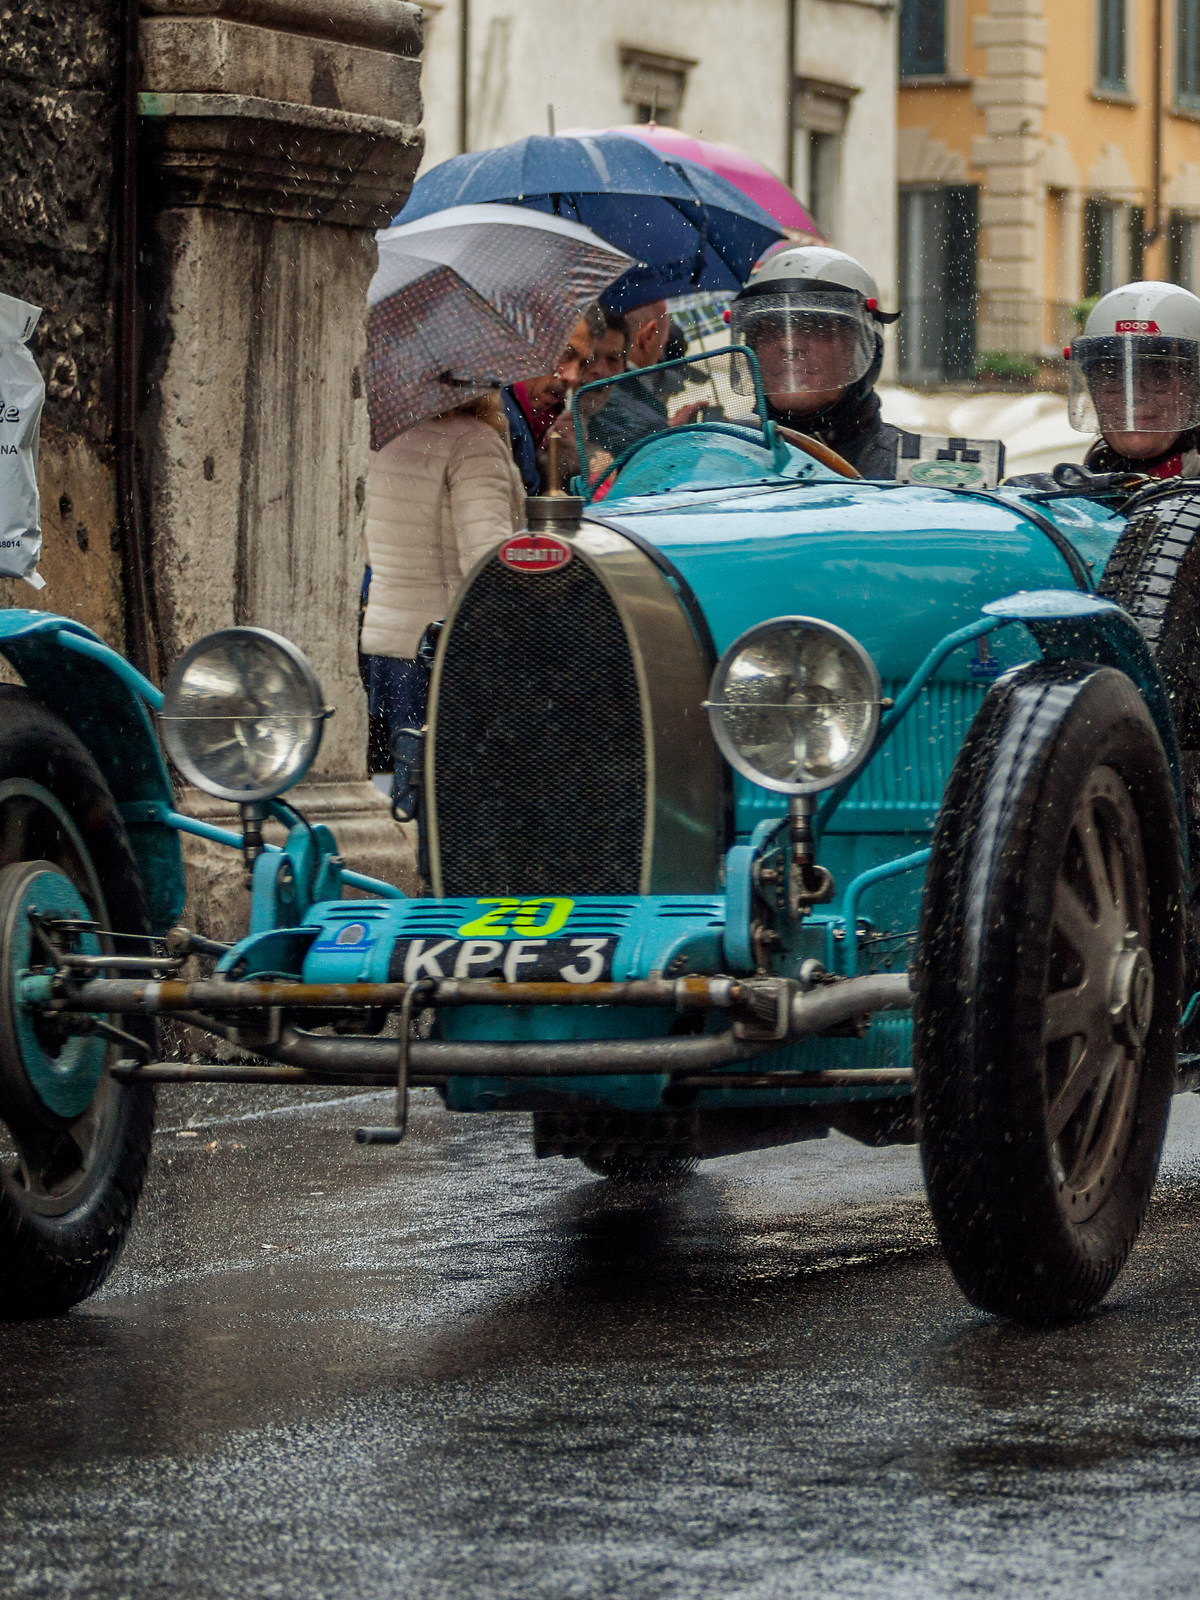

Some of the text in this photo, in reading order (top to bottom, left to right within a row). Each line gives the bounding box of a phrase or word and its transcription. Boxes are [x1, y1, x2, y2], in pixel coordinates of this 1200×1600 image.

[1119, 321, 1150, 330] 1000
[506, 548, 564, 561] BUGATTI
[457, 897, 575, 937] 20
[403, 938, 608, 984] KPF 3
